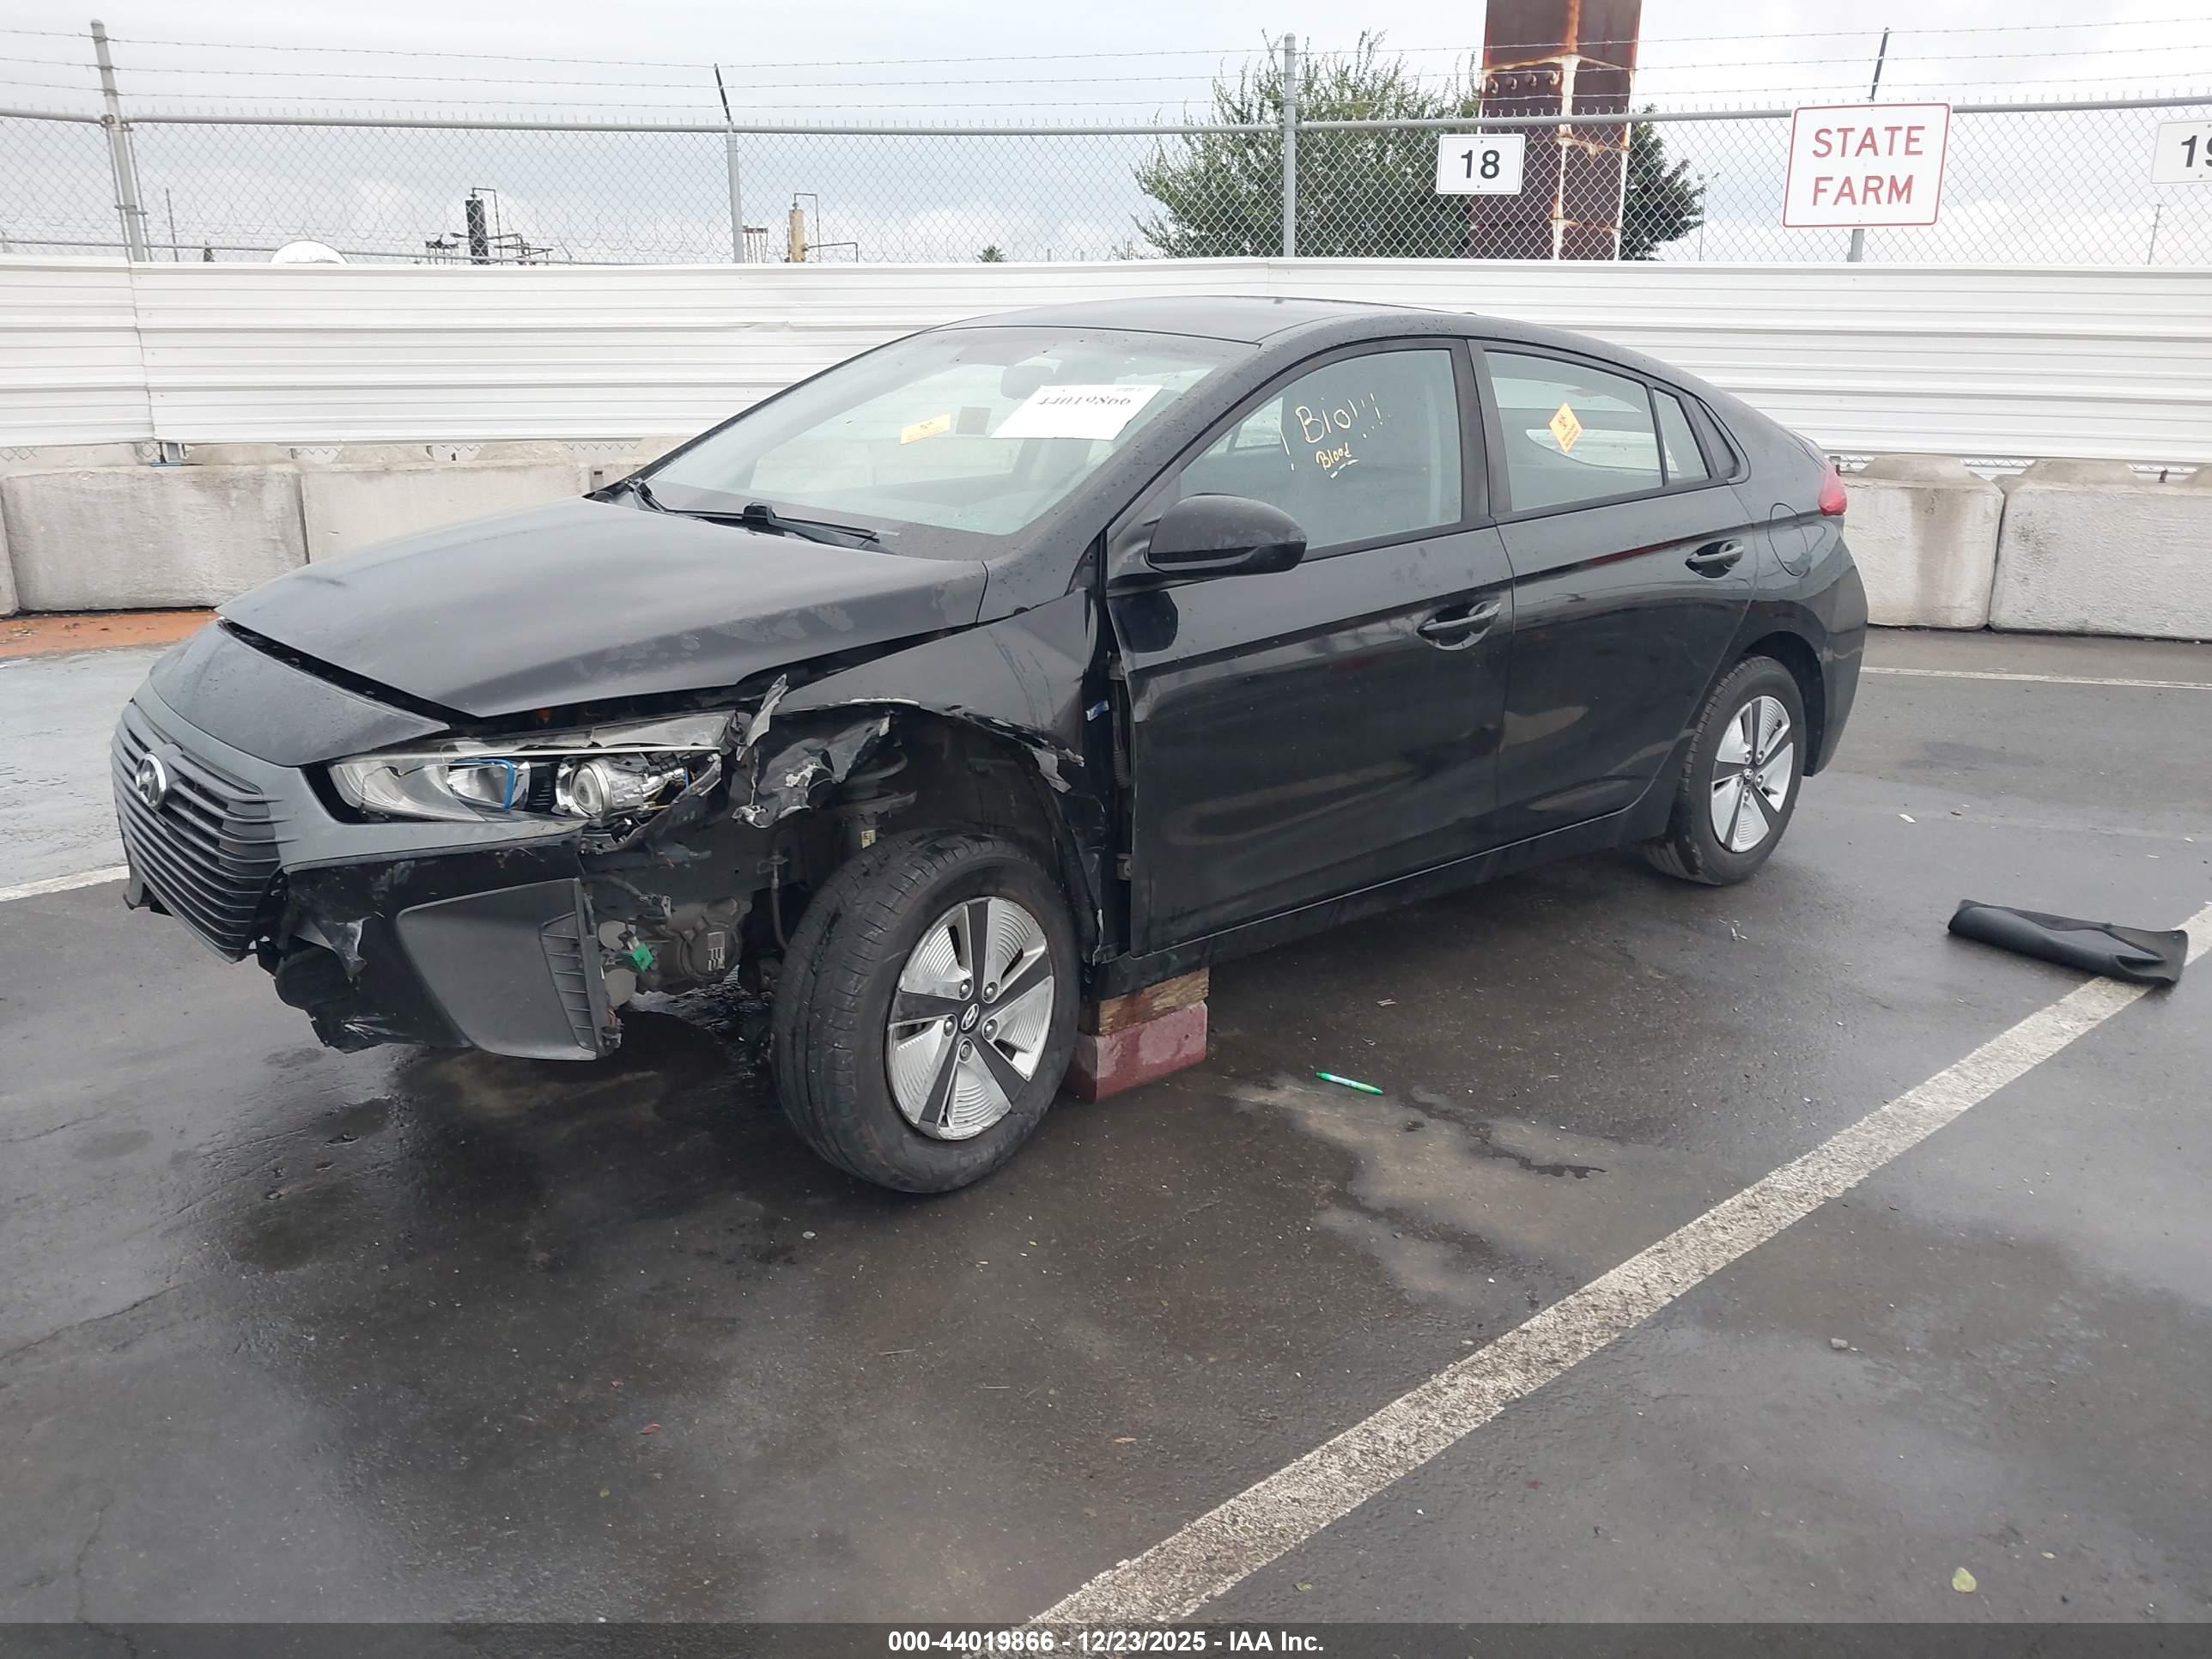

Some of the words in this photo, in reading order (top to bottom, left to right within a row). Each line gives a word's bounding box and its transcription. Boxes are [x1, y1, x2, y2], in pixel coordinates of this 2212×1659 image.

[1812, 125, 1926, 158] STATE
[1461, 149, 1500, 179] 18
[1812, 174, 1914, 206] FARM
